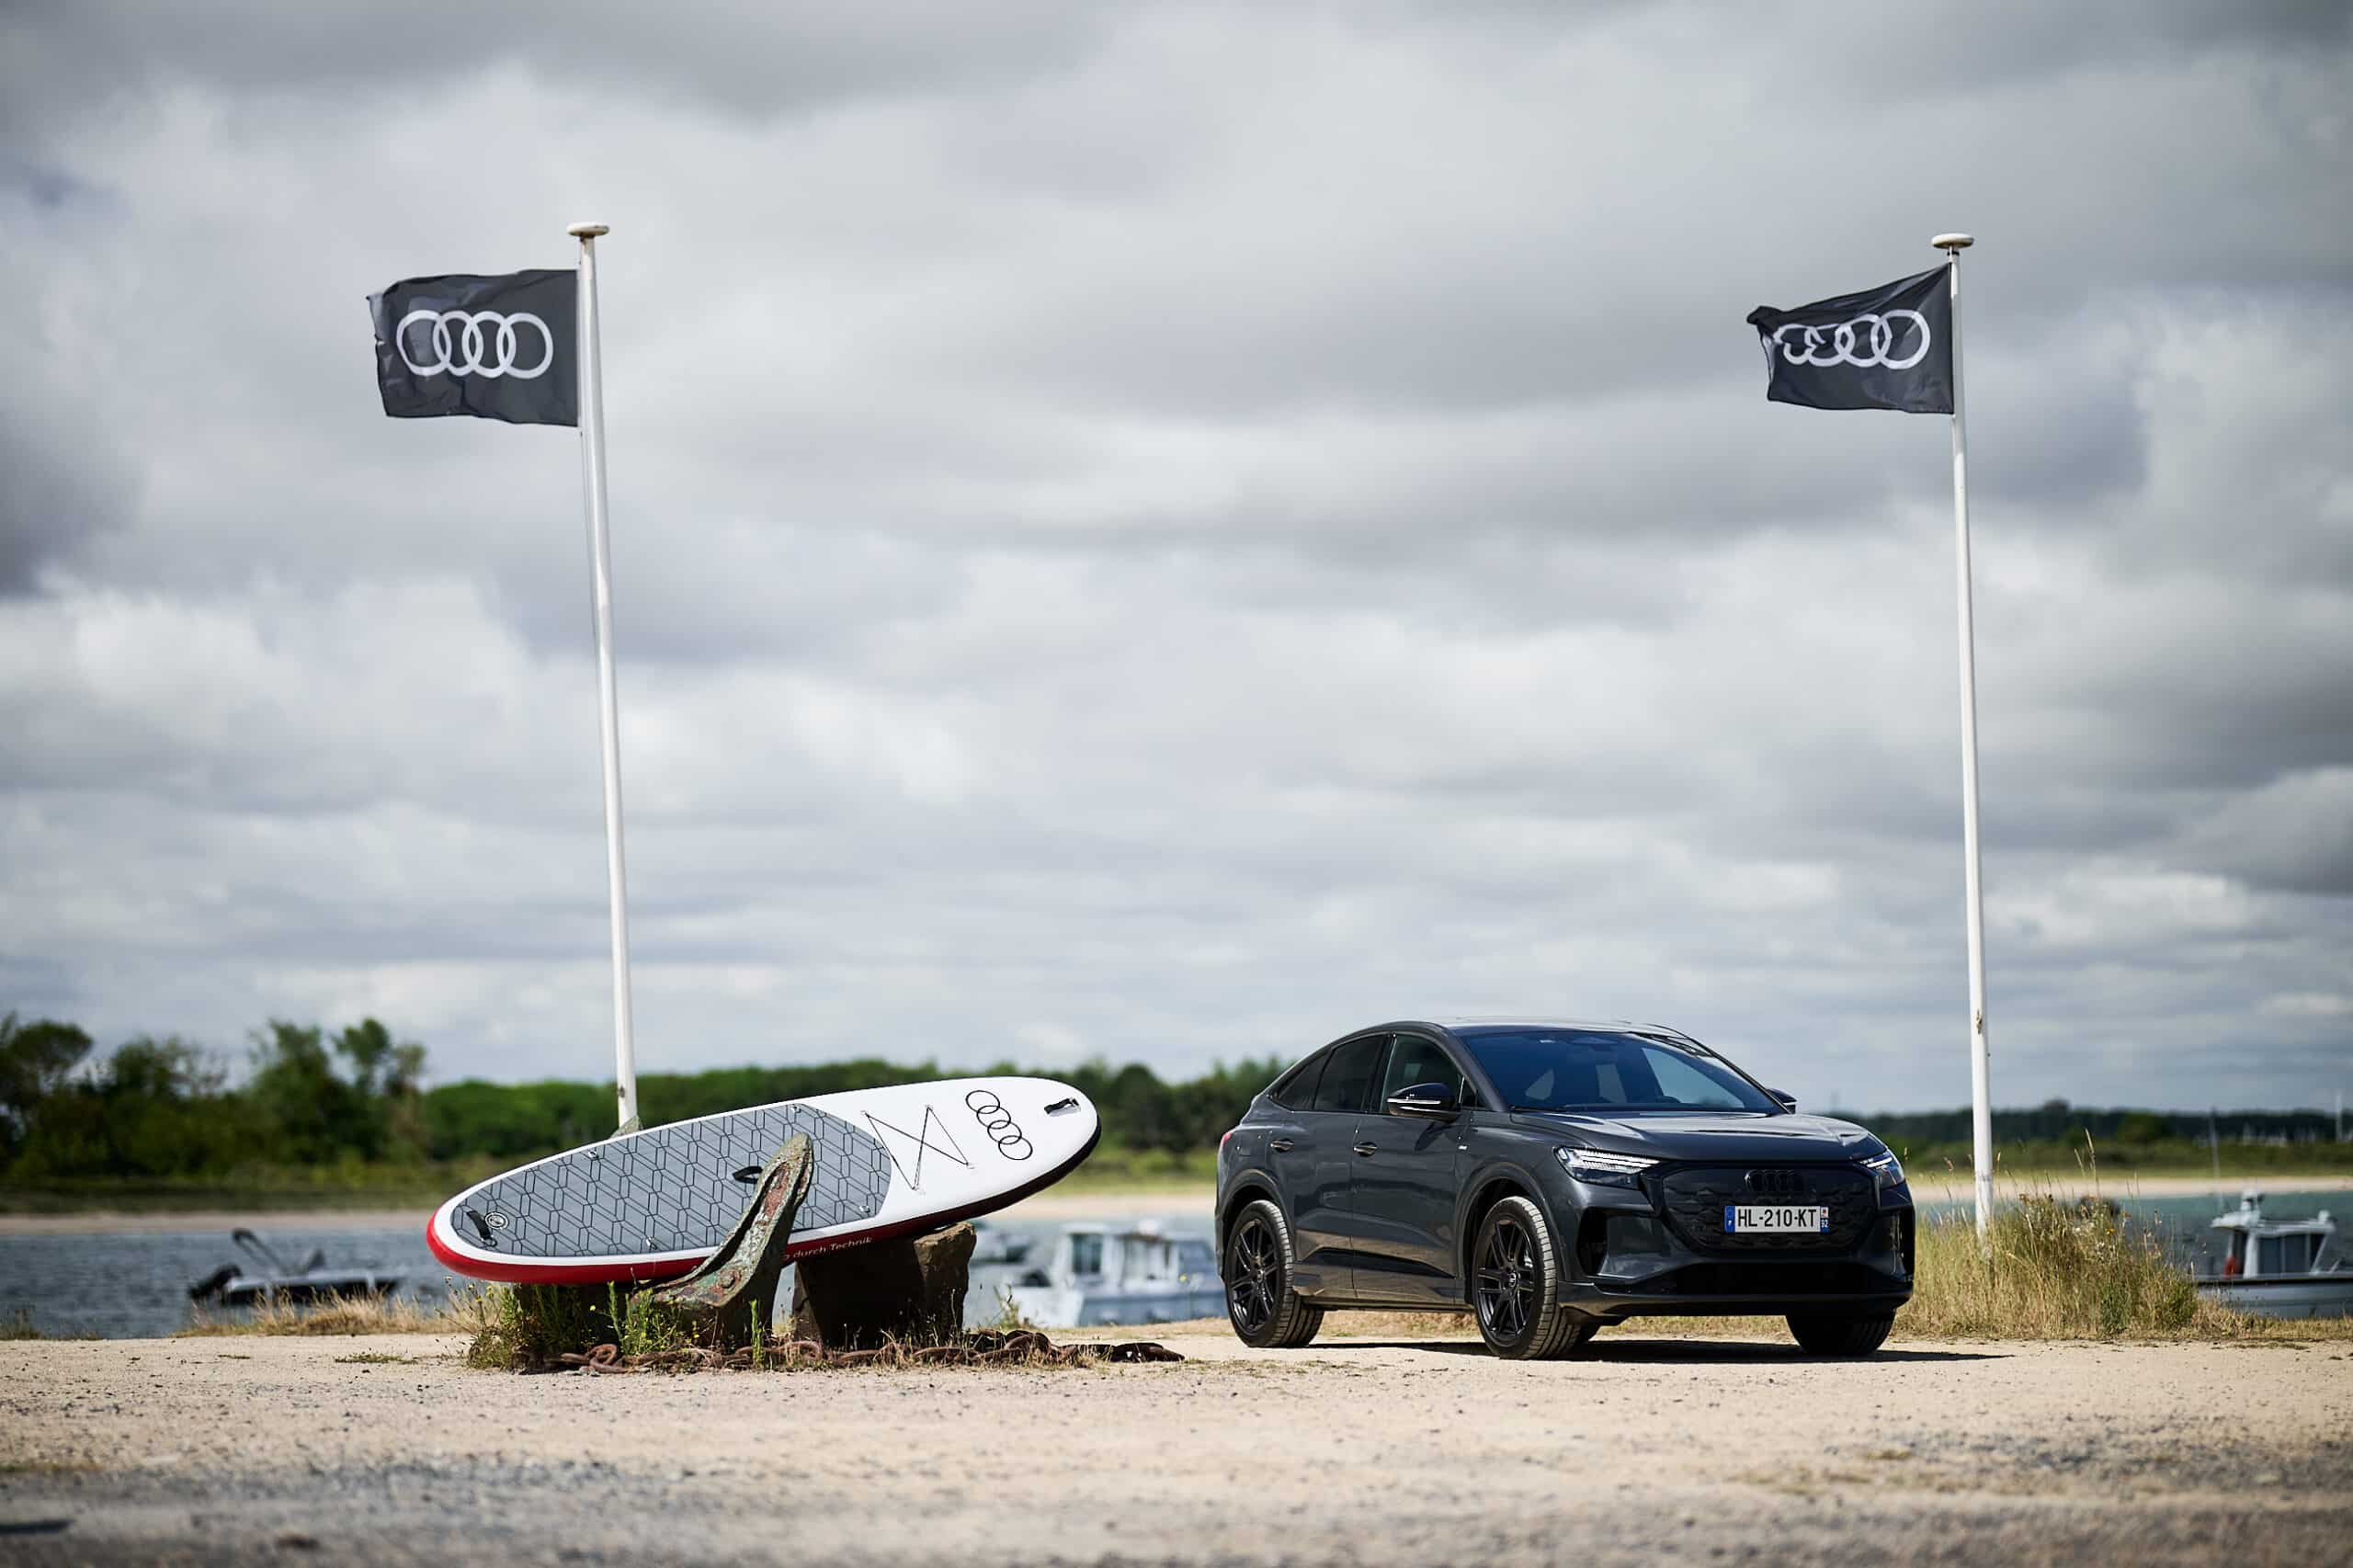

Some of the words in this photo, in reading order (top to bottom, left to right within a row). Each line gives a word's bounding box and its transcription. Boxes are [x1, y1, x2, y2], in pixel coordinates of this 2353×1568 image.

[1737, 1209, 1817, 1227] HL-210-KT
[792, 1245, 827, 1258] durch
[830, 1236, 873, 1251] Technik
